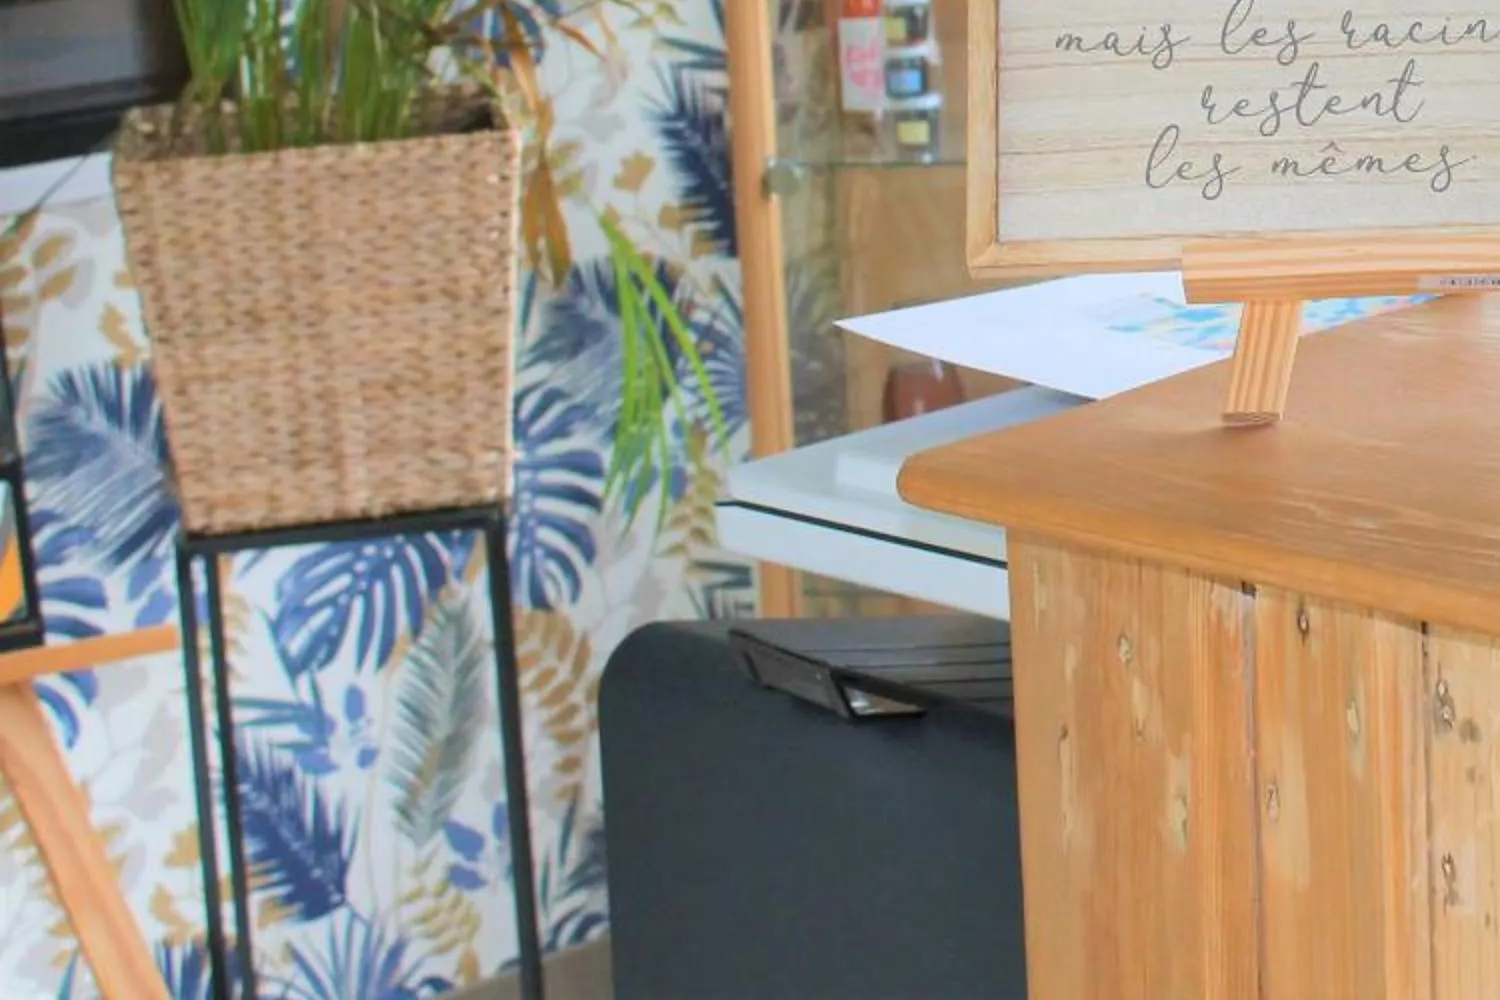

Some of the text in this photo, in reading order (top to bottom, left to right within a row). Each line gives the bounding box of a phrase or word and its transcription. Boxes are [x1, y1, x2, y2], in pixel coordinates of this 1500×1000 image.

[1055, 22, 1190, 69] mais
[1200, 58, 1424, 136] restent
[1145, 124, 1240, 200] les
